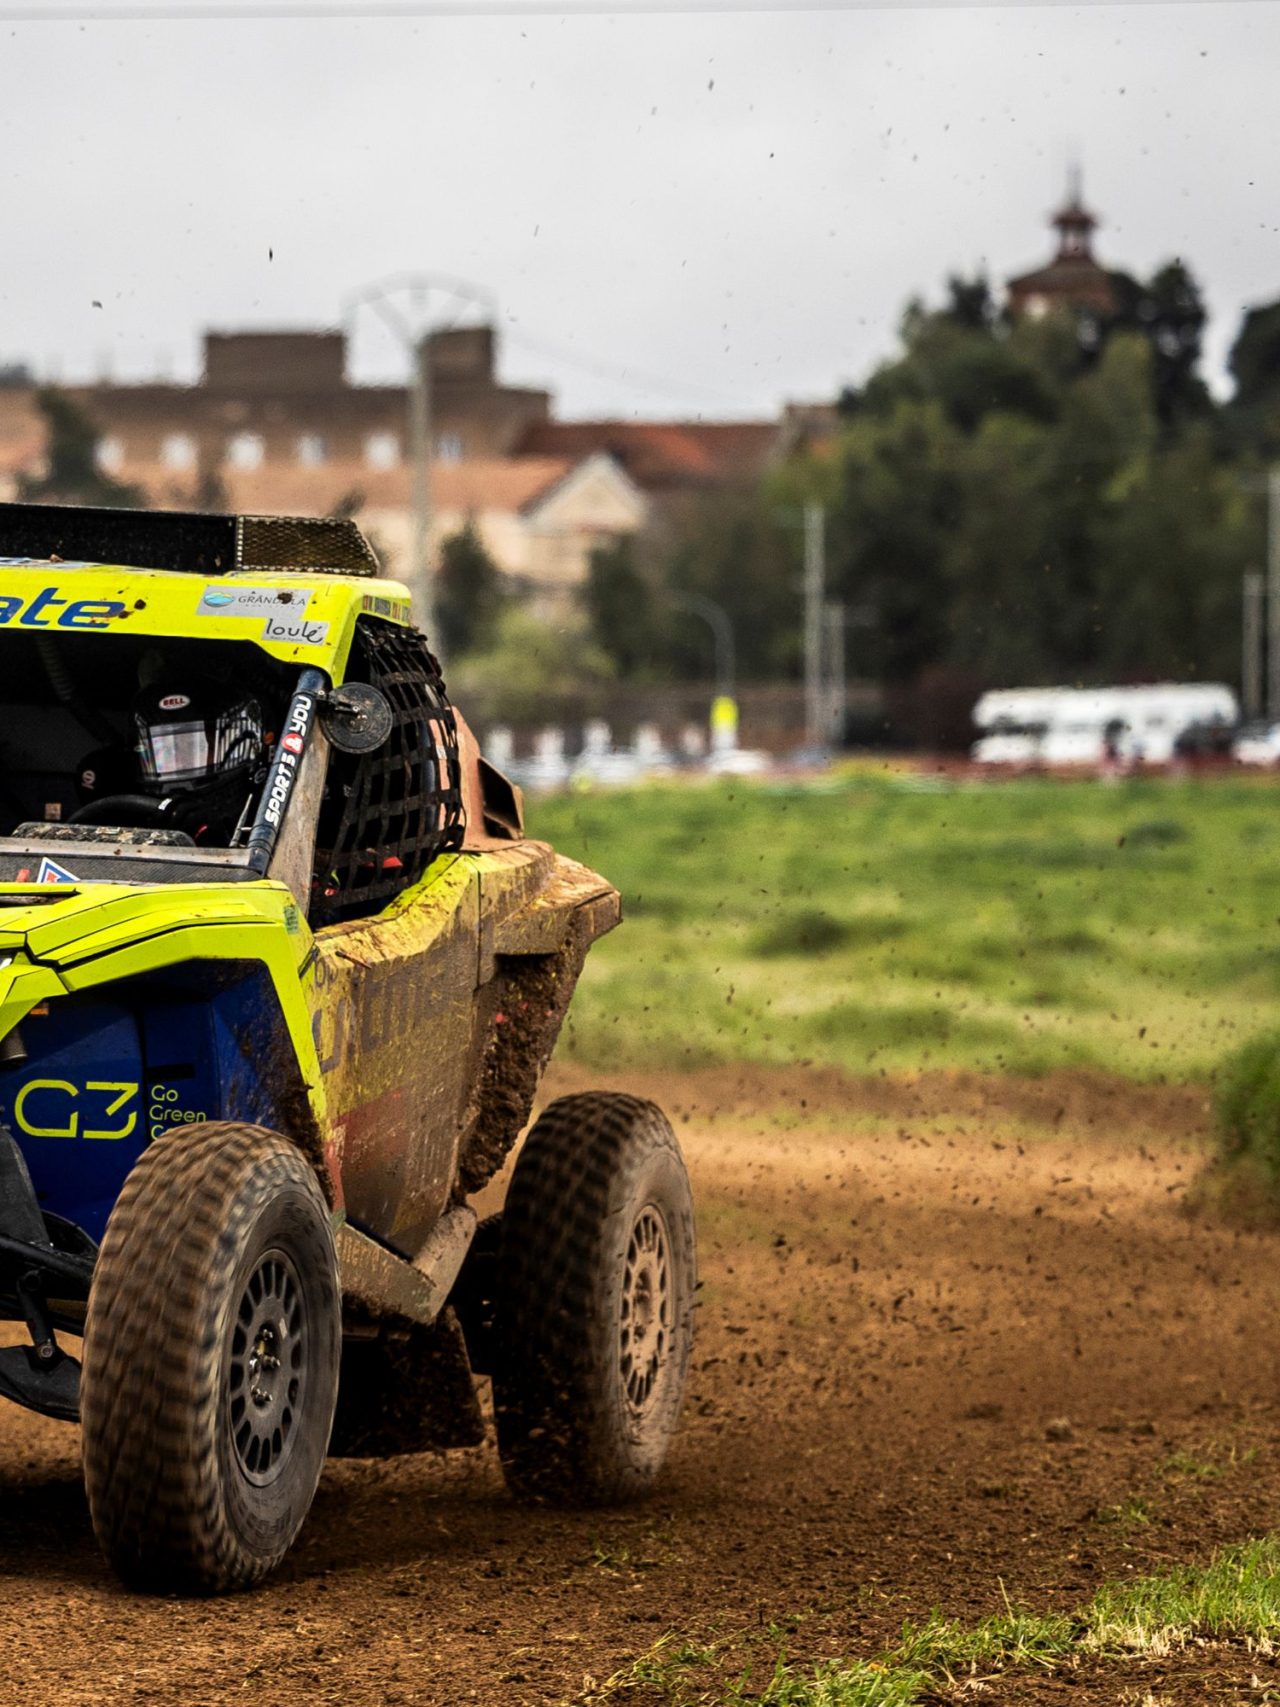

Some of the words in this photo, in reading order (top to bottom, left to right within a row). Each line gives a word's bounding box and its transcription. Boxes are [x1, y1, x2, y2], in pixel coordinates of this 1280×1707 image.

[266, 618, 324, 643] loulé
[163, 697, 186, 706] BELL
[264, 752, 296, 827] SPORTS
[289, 694, 313, 736] YOU
[150, 1084, 178, 1102] Go
[14, 1078, 139, 1140] G3
[149, 1105, 207, 1123] Green
